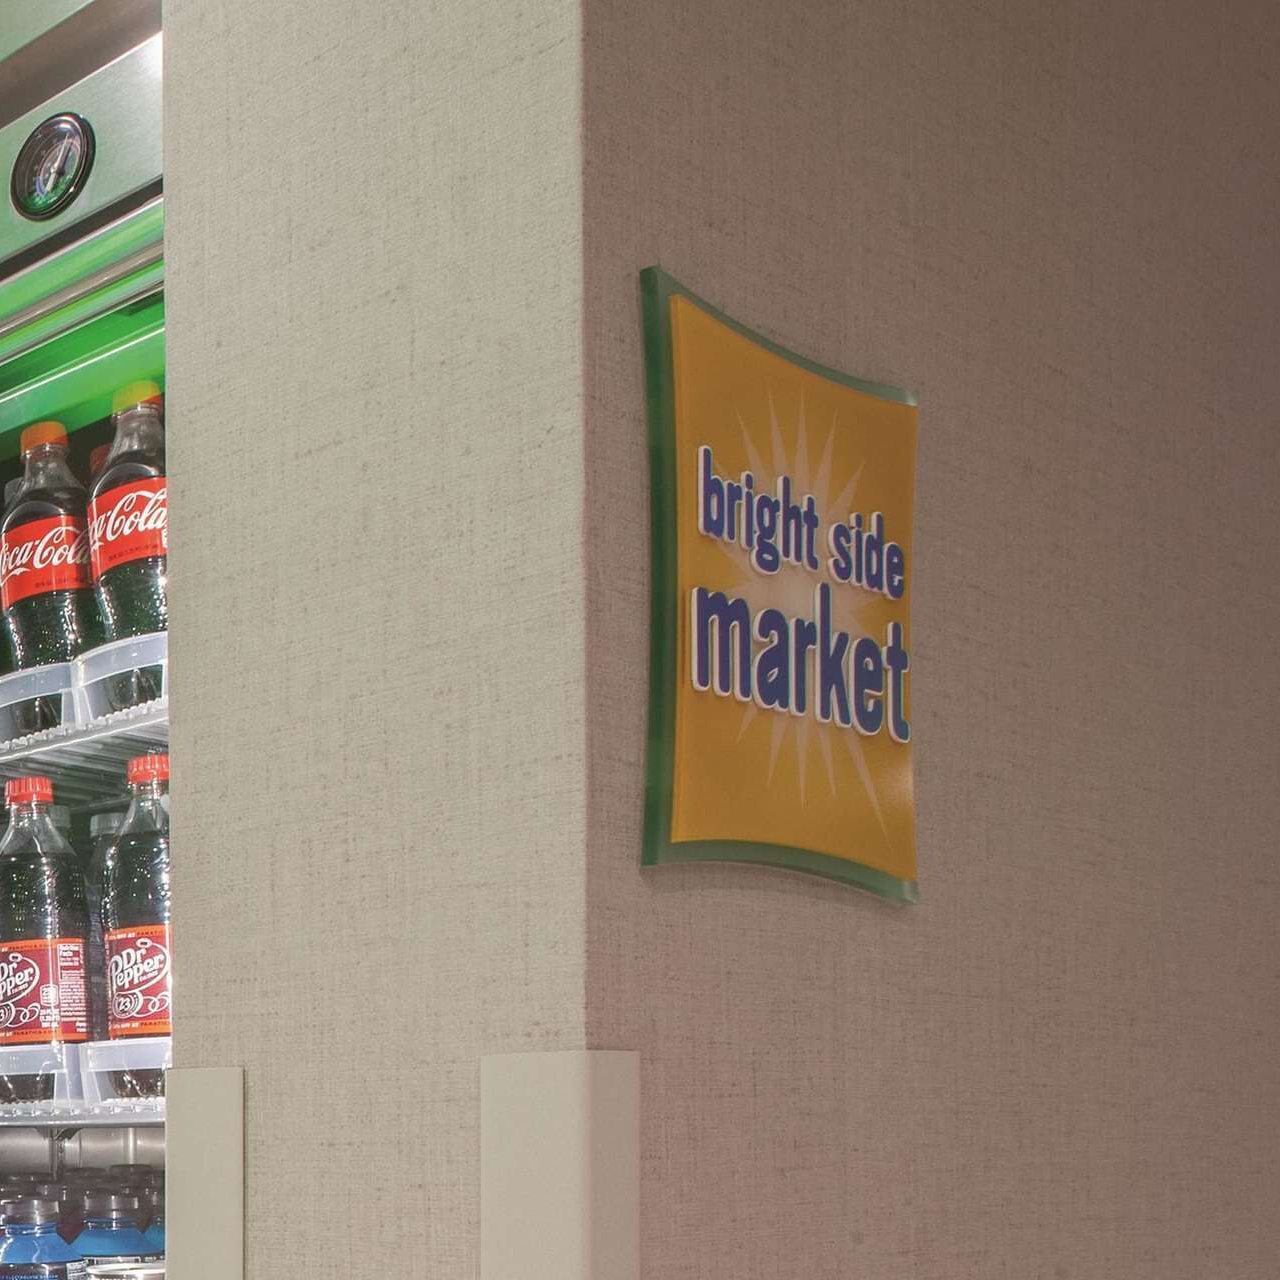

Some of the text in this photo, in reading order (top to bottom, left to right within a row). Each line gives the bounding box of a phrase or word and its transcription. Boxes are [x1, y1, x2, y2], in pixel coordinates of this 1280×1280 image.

[697, 445, 906, 600] bright side
[691, 582, 911, 743] market
[122, 948, 146, 966] Dr
